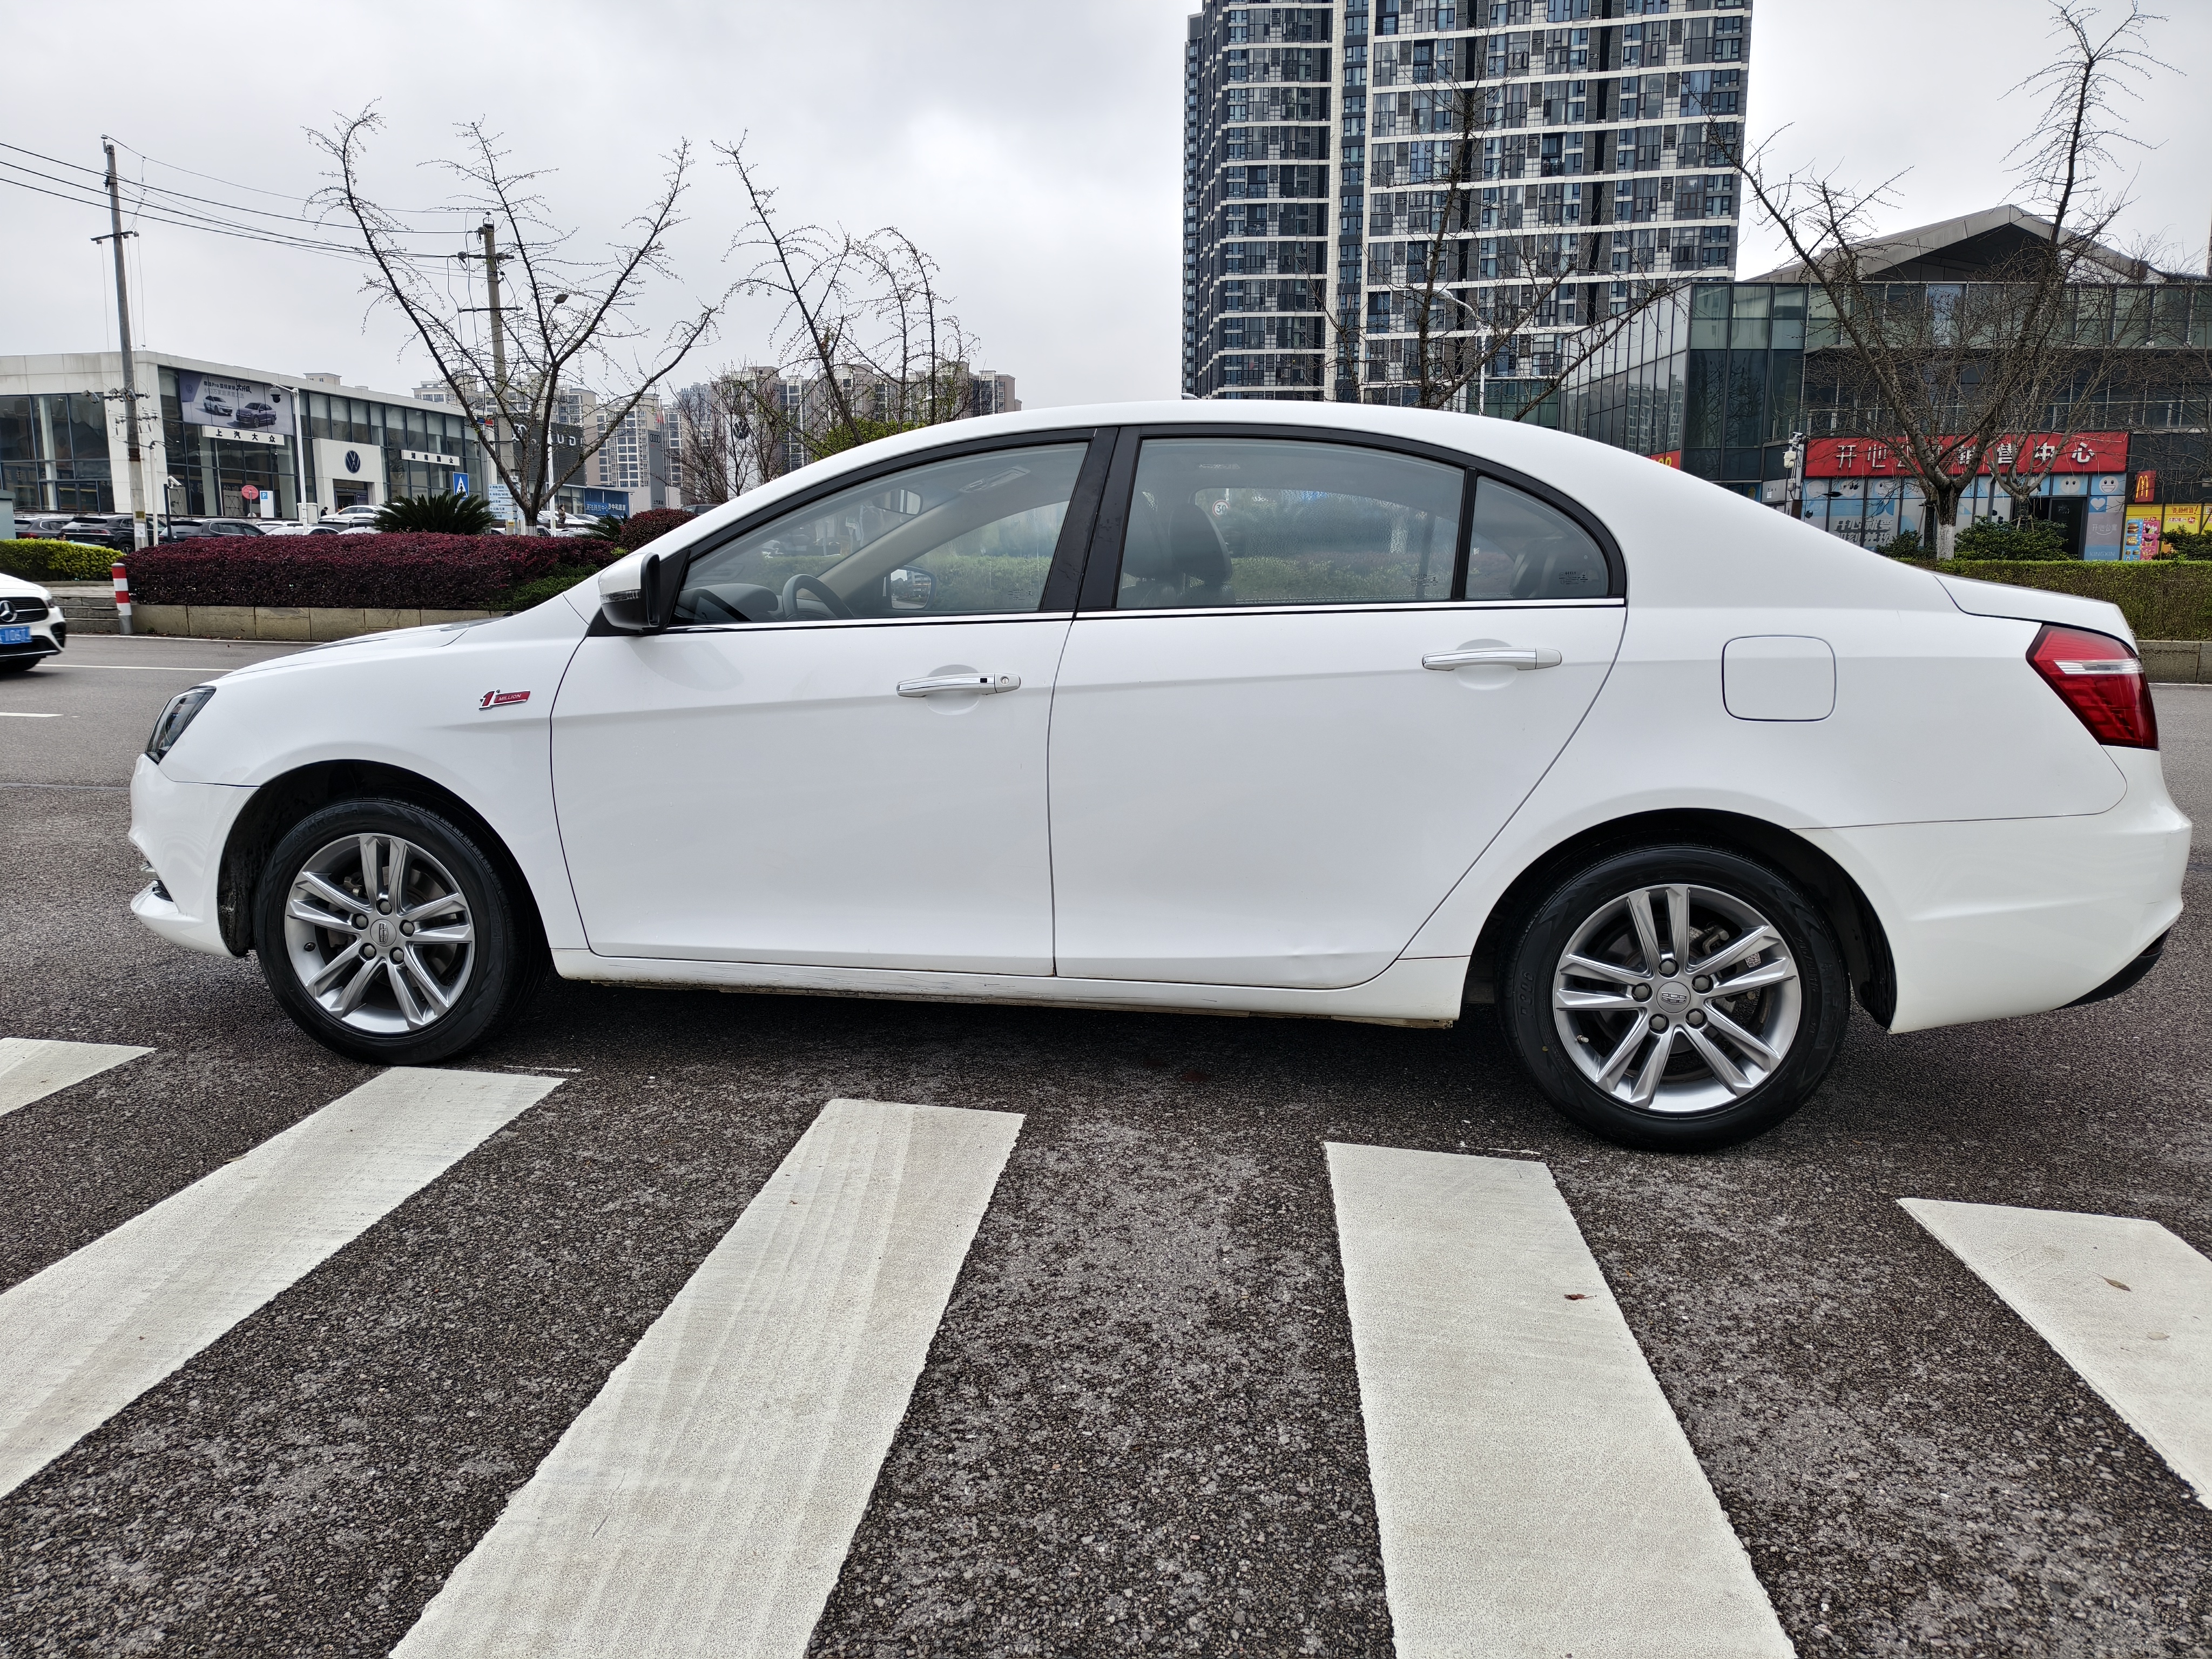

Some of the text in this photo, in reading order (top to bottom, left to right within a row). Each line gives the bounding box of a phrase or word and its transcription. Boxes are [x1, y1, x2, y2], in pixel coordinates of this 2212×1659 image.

[216, 429, 275, 443] 上汽大众
[480, 691, 495, 708] 1
